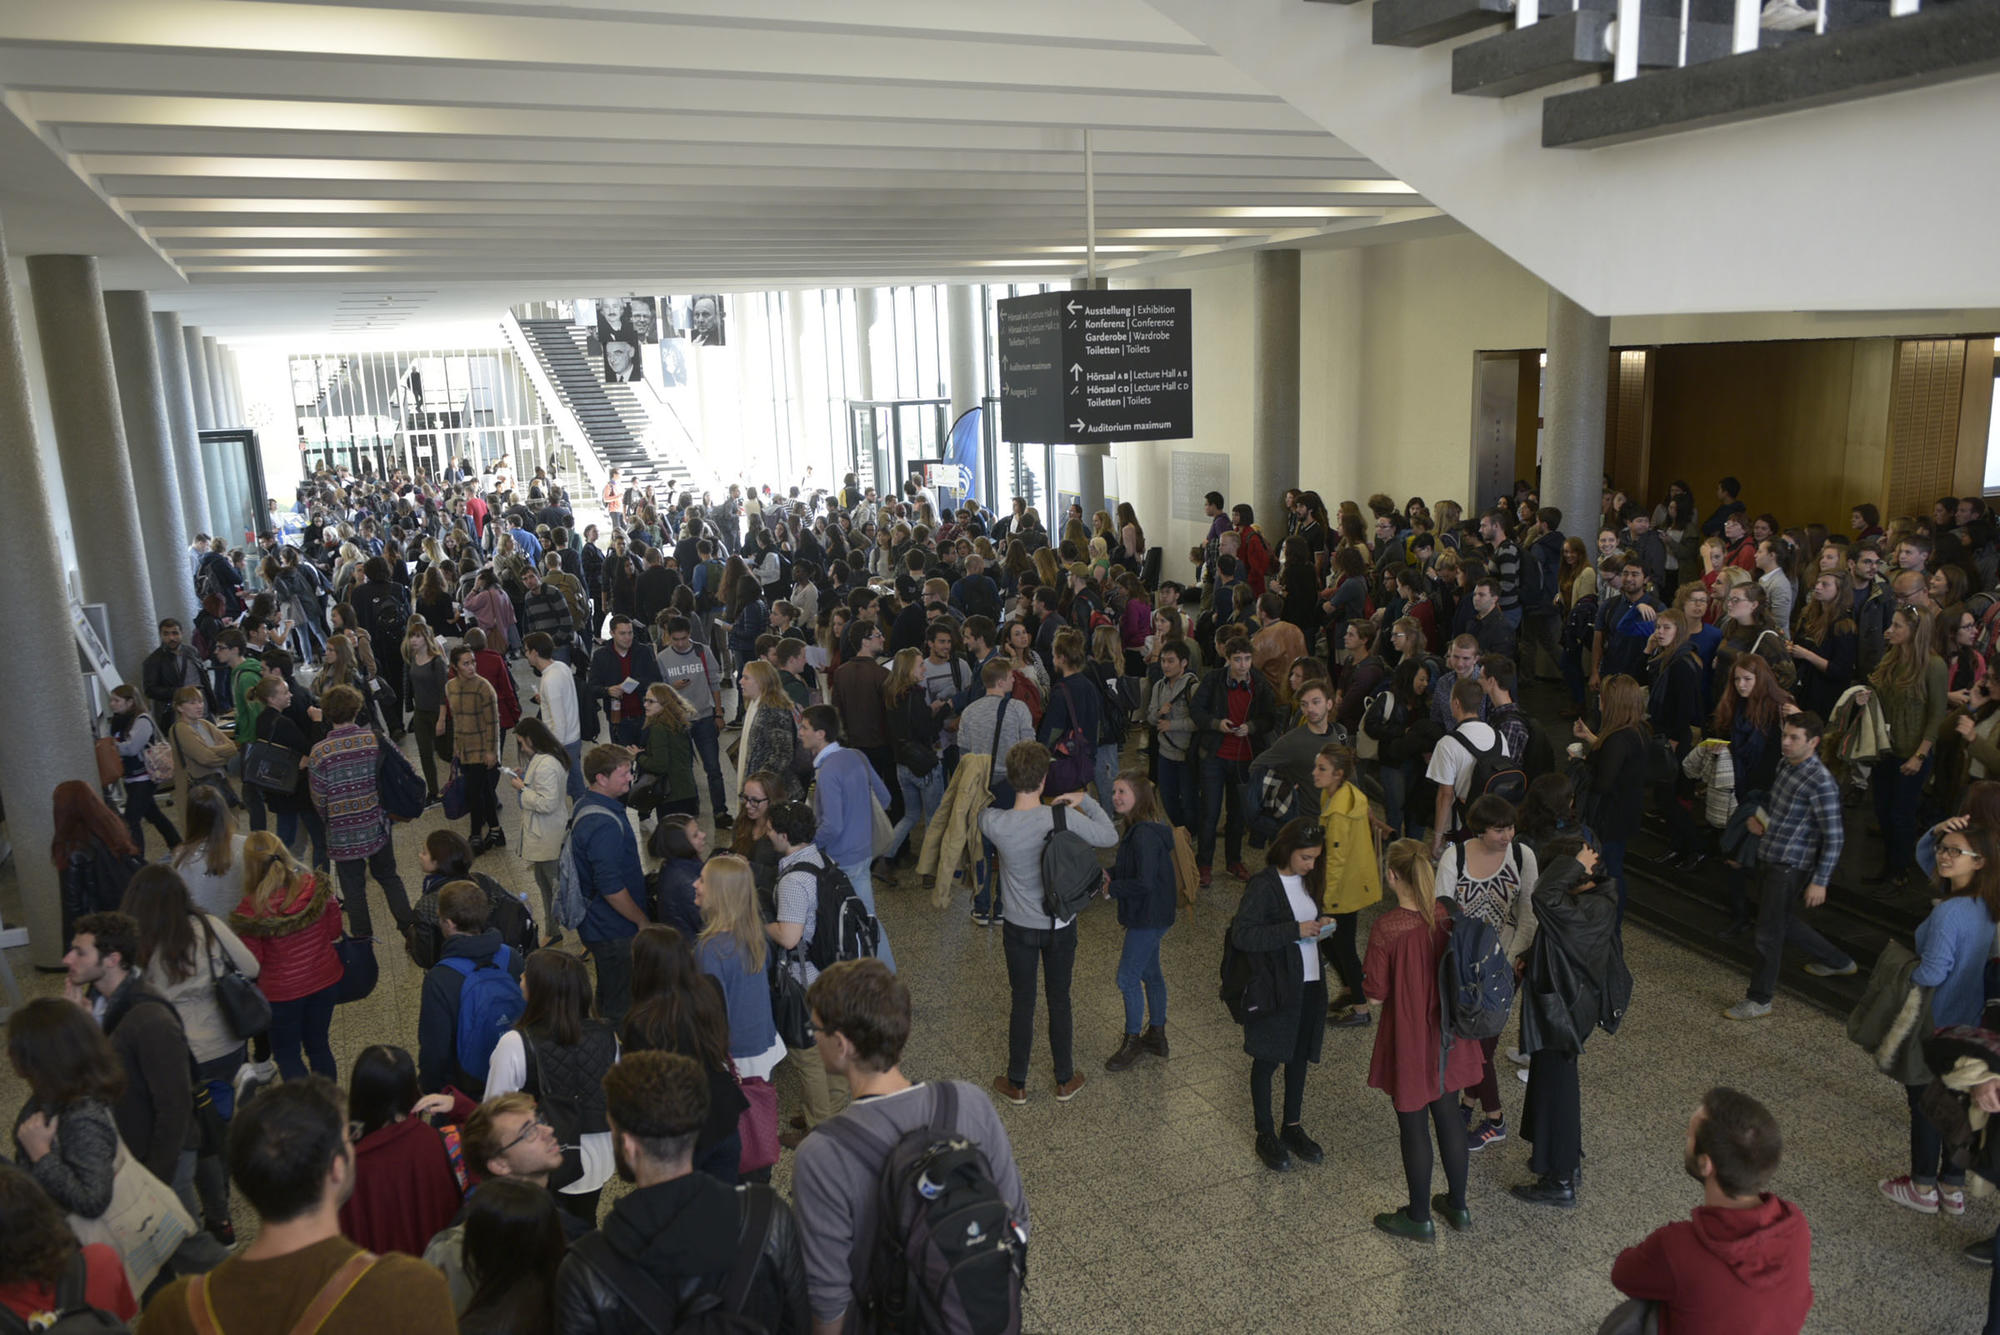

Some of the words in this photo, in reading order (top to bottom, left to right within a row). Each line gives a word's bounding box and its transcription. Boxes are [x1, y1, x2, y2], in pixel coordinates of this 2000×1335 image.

[1085, 306, 1131, 317] Ausstellung
[1138, 305, 1175, 314] Exhibition
[1085, 319, 1125, 329] Konferenz
[1131, 318, 1174, 327] Conference
[1085, 332, 1127, 342] Garderobe
[1133, 331, 1170, 340] Wardrobe
[1086, 346, 1120, 355] Toiletten
[1126, 344, 1150, 354] Toilets
[1086, 371, 1116, 381] Hörsaal
[1134, 370, 1160, 380] Lecture
[1162, 369, 1176, 378] Hall
[1087, 384, 1116, 394] Hörsaal
[1134, 383, 1160, 393] Lecture
[1162, 381, 1176, 390] Hall
[1087, 398, 1121, 407] Toiletten
[1127, 396, 1151, 405] Toilets
[1088, 422, 1132, 433] Auditorium
[1134, 420, 1172, 431] maximum
